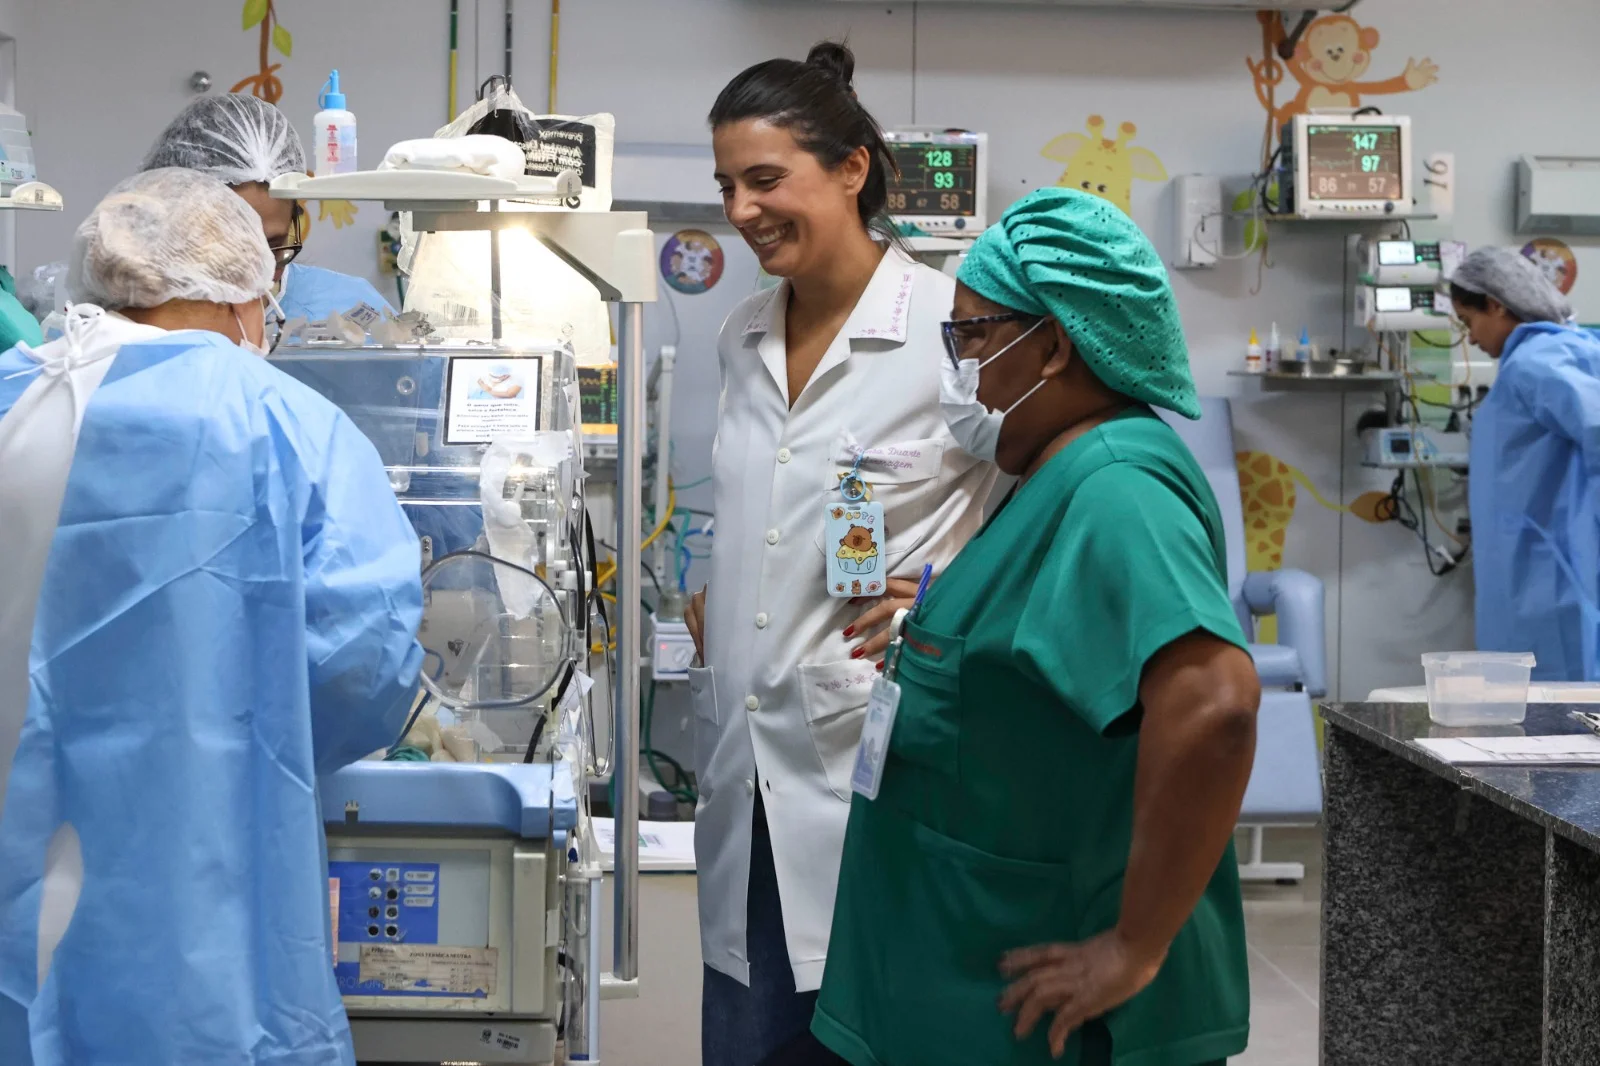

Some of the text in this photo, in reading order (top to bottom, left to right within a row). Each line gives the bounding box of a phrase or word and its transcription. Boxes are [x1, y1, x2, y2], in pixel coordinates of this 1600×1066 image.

[1352, 133, 1378, 150] 147
[925, 150, 952, 167] 128
[1361, 155, 1380, 172] 97
[934, 172, 954, 189] 93
[887, 447, 921, 458] Duarte
